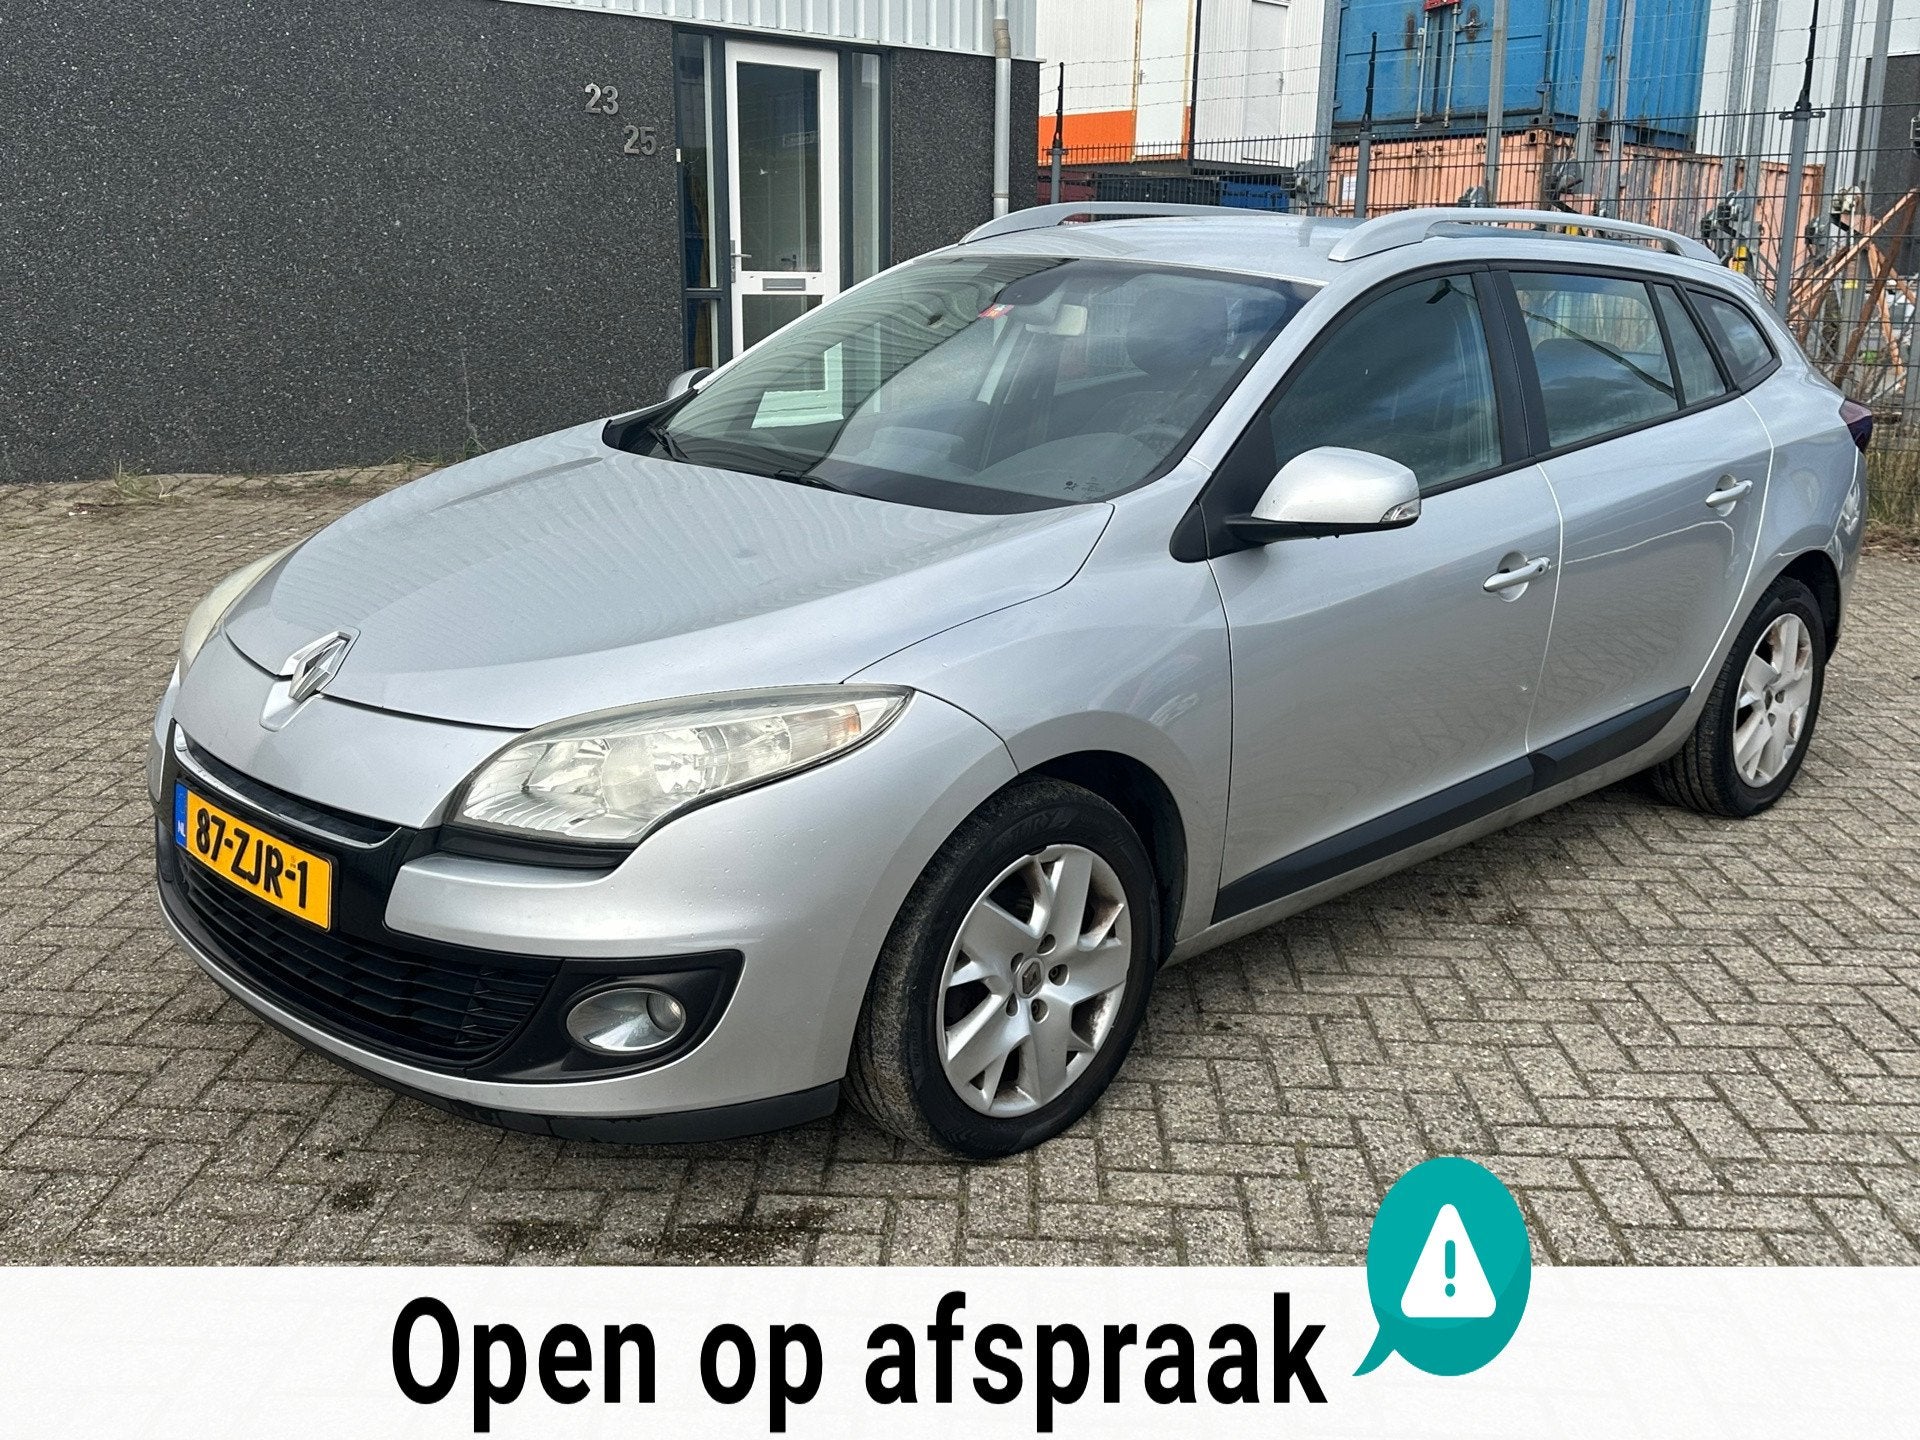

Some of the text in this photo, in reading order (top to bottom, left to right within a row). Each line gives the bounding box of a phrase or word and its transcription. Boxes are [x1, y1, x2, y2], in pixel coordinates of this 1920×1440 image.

[584, 82, 619, 115] 23
[623, 124, 657, 156] 25
[196, 808, 308, 909] 87-ZJR-1
